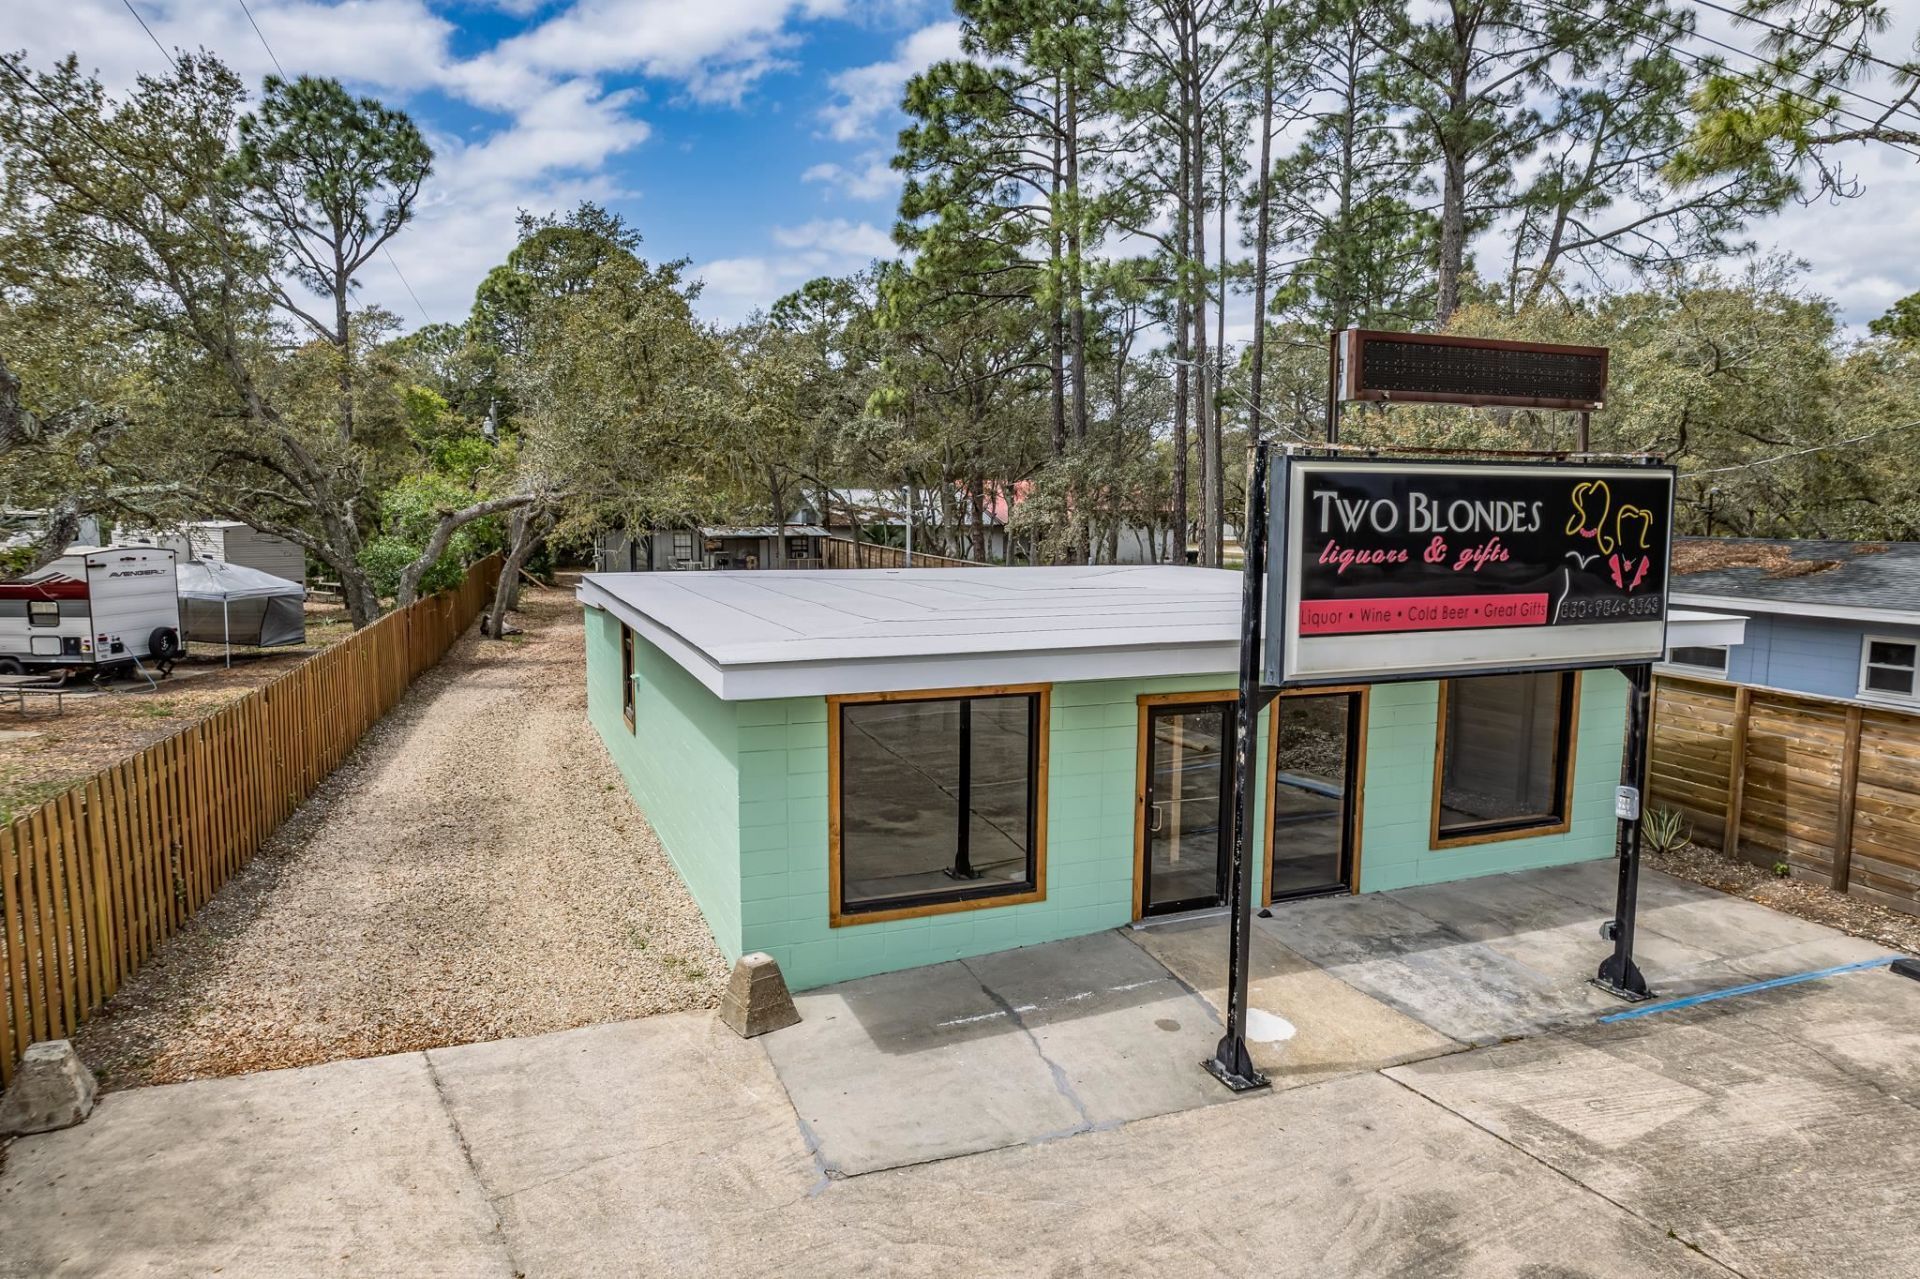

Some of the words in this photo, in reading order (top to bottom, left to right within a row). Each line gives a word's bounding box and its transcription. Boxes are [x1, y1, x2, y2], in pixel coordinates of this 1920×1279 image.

[1319, 540, 1408, 574] liquors
[1424, 536, 1447, 562] &
[1454, 538, 1509, 571] gifts
[109, 569, 158, 577] AVENGER
[1301, 610, 1342, 626] Liquor
[1360, 608, 1390, 621] Wine
[1409, 606, 1437, 621] Cold
[1442, 606, 1469, 619] Beer
[1484, 602, 1518, 617] Great
[1521, 600, 1546, 616] Gifts
